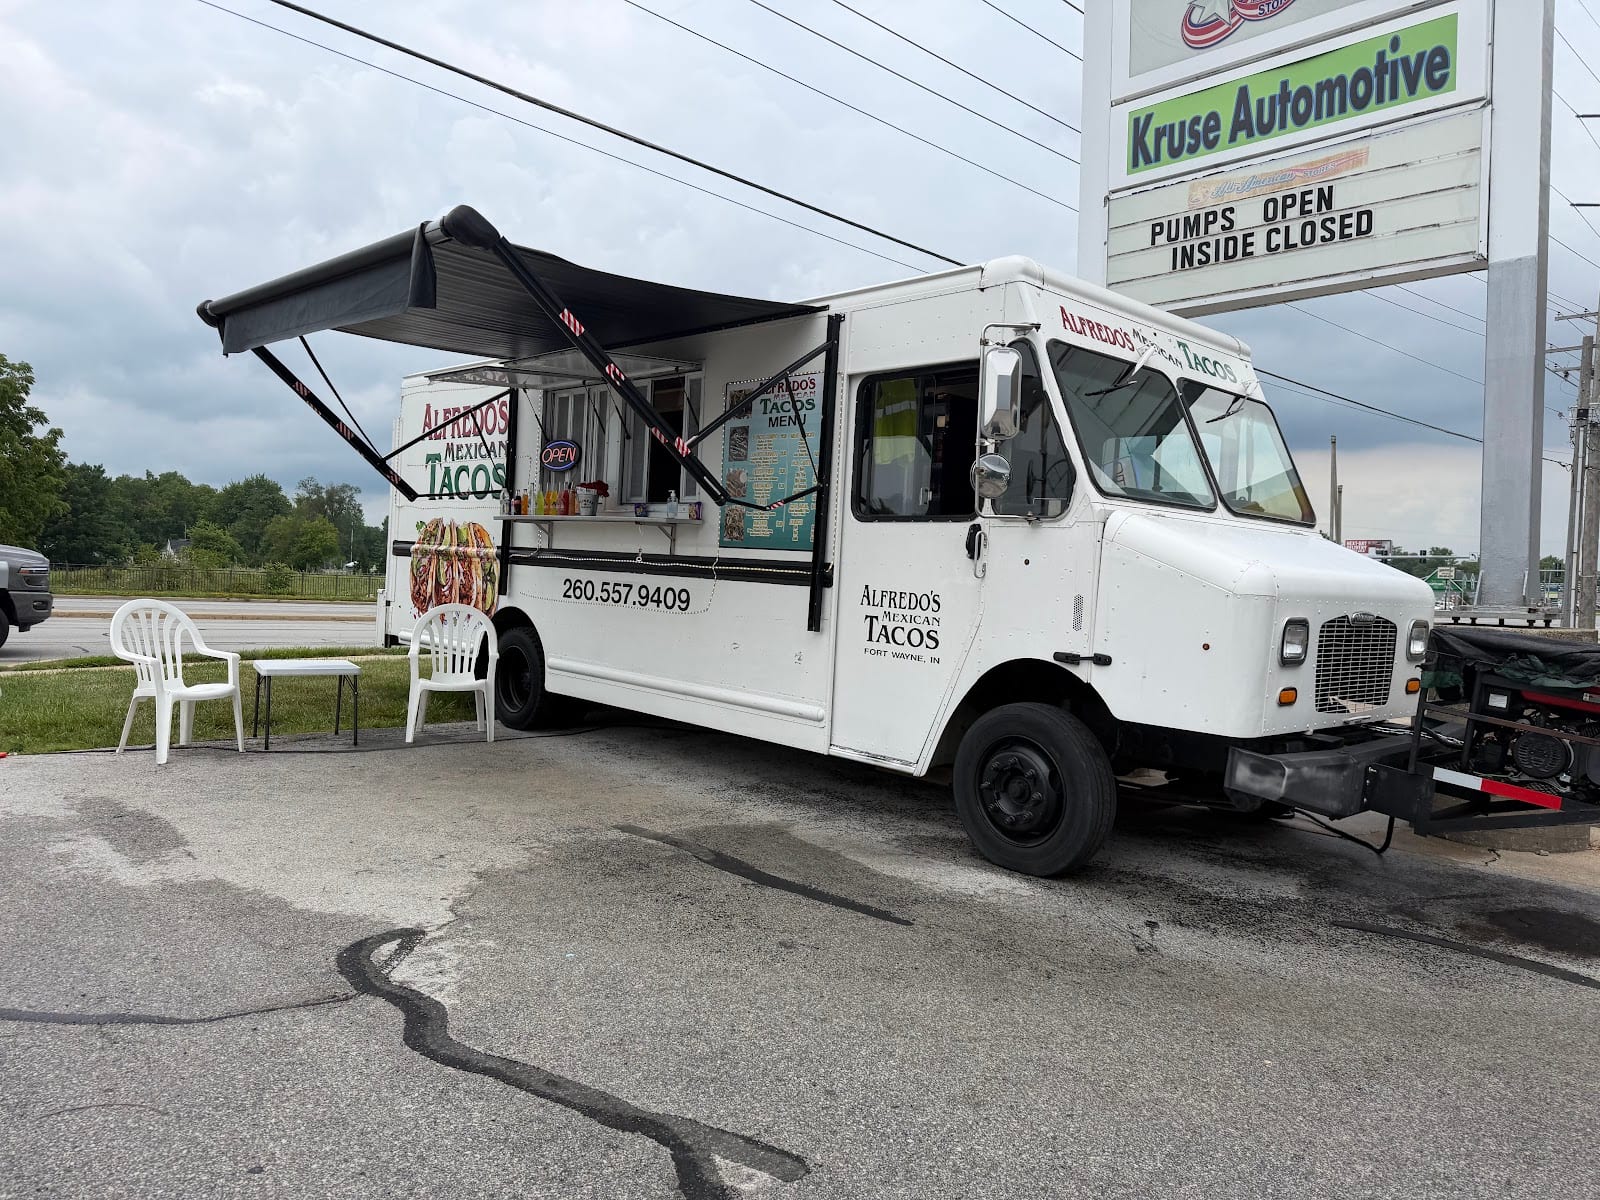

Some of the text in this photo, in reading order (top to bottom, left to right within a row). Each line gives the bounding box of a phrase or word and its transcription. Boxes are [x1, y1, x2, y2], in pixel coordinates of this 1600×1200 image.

[1131, 34, 1450, 169] Kruse Automotive
[1151, 185, 1334, 246] PUMPS OPEN
[1172, 209, 1373, 270] INSIDE CLOSED
[1059, 305, 1135, 352] ALFREDO'S
[1177, 340, 1238, 383] TACOS
[422, 399, 509, 441] ALFREDO'S
[760, 398, 816, 415] TACOS
[444, 440, 508, 461] MEXICAN
[541, 447, 577, 464] OPEN
[425, 453, 507, 500] TACOS
[563, 578, 690, 611] 260.557.9409
[860, 584, 941, 612] ALFREDO'S
[864, 615, 940, 650] TACOS
[882, 611, 941, 626] MEXICAN
[864, 647, 940, 664] FORT WAYNE, IN
